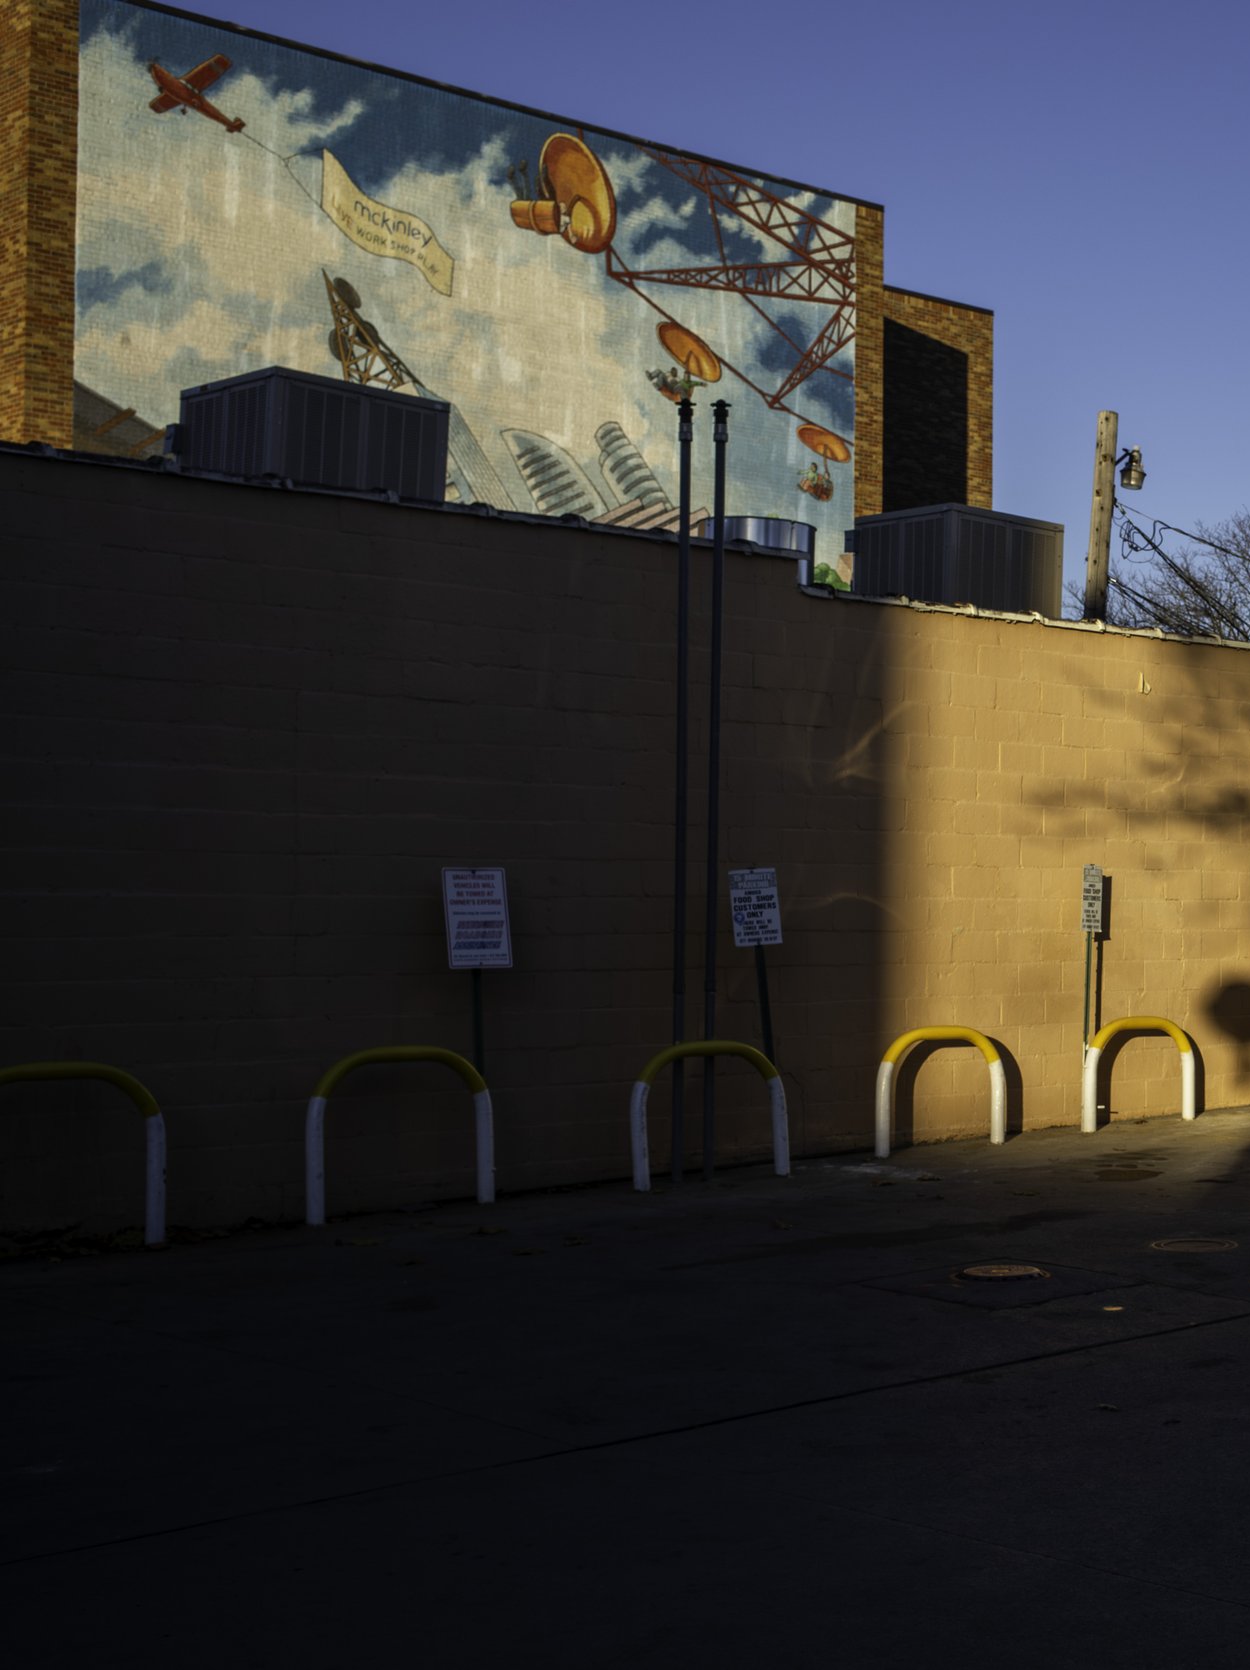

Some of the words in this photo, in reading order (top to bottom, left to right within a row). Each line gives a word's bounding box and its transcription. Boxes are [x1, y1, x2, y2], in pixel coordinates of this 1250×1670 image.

[354, 200, 432, 248] mckinley
[356, 226, 387, 247] WORK
[390, 240, 416, 256] SHOP
[734, 903, 776, 911] CUSTOMERS
